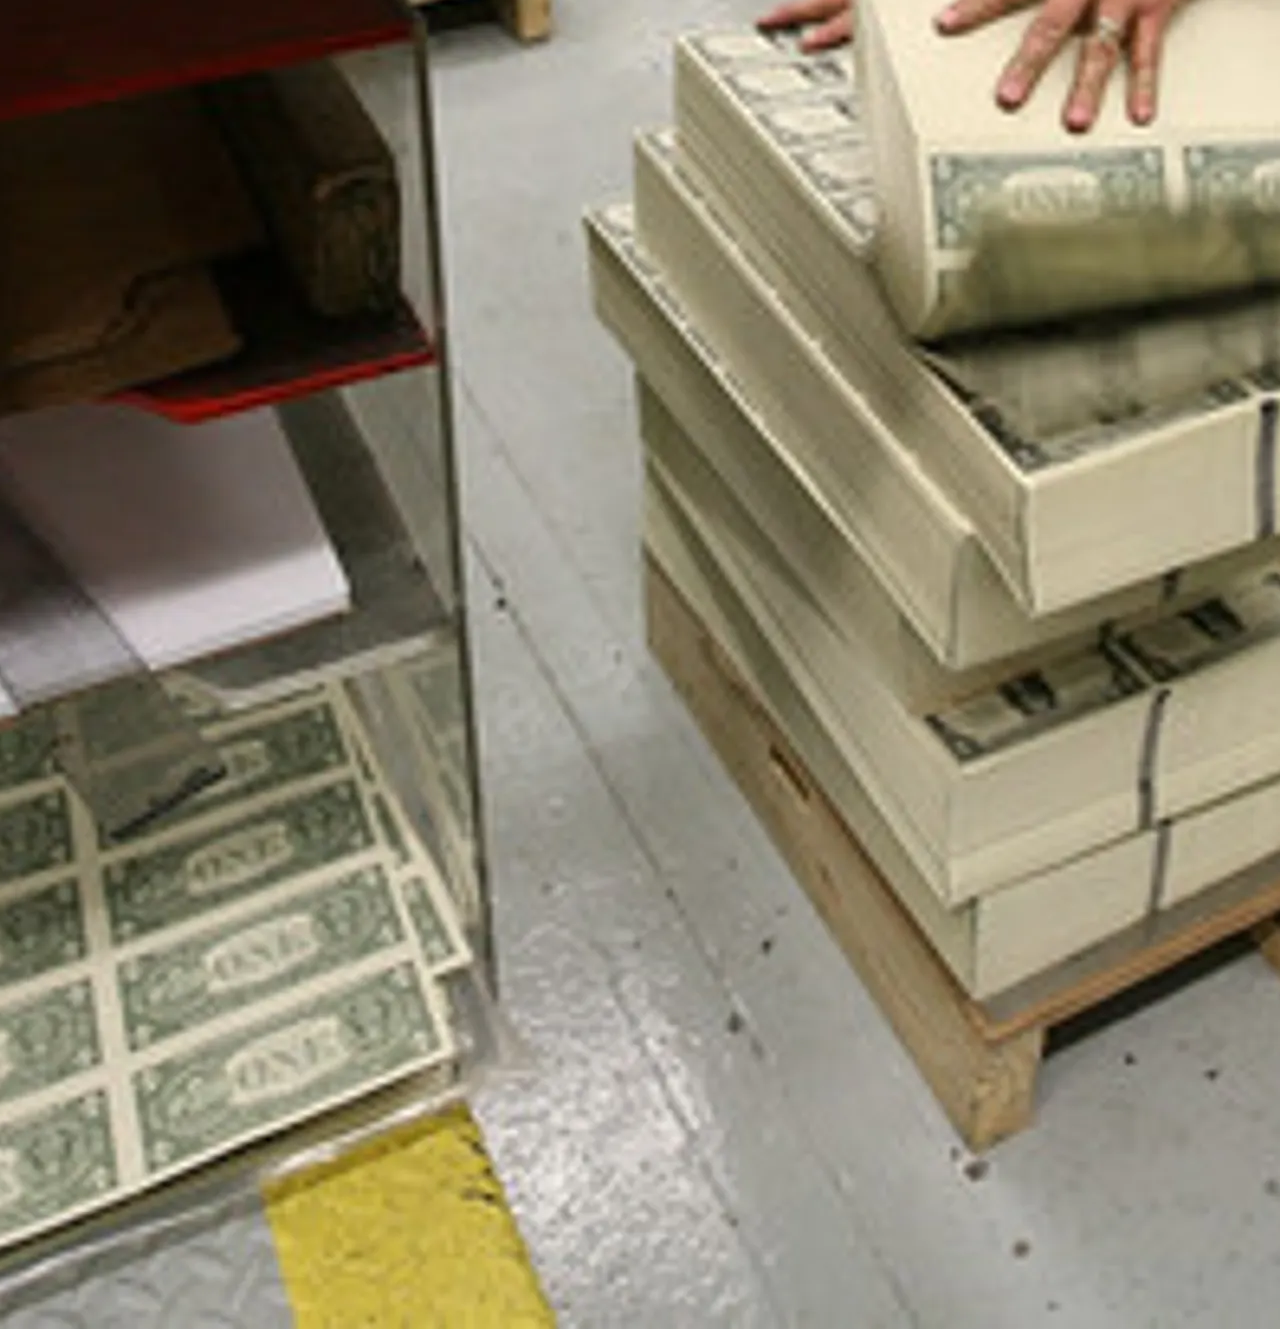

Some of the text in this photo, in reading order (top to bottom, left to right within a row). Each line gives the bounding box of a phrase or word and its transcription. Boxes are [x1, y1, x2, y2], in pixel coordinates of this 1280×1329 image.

[194, 829, 287, 880] ONE
[214, 922, 312, 976] ONE
[238, 1024, 340, 1088] ONE
